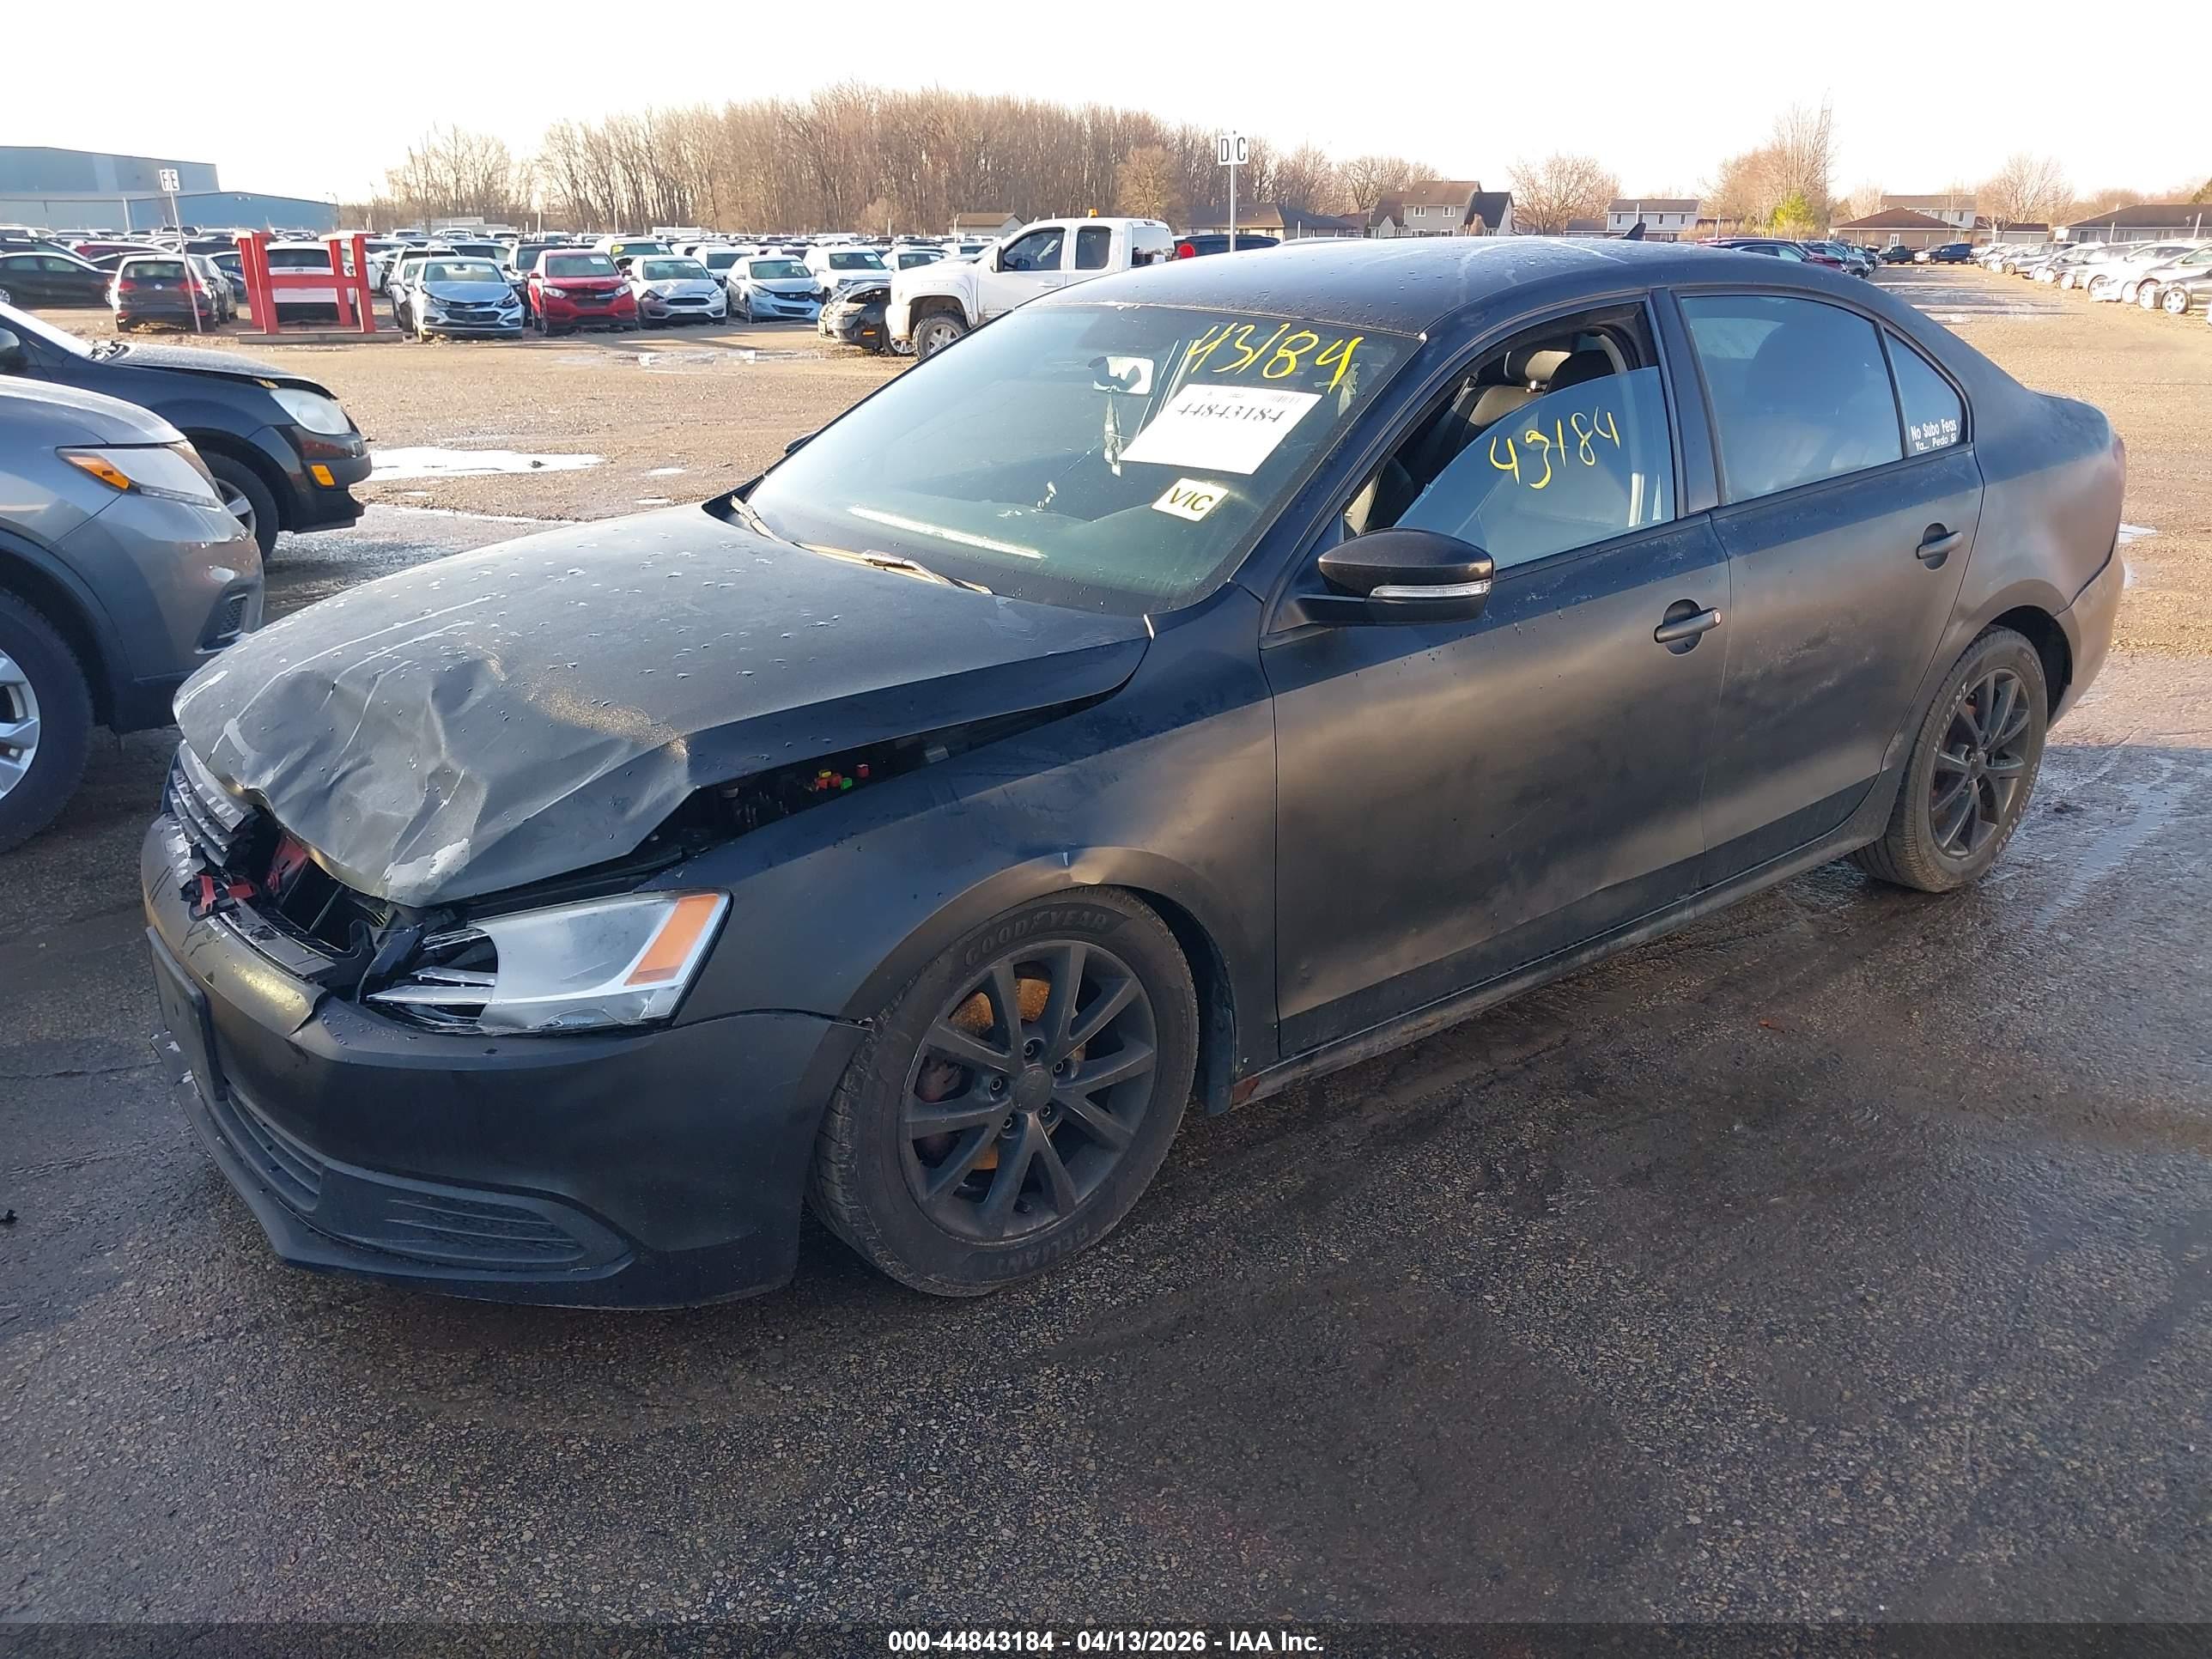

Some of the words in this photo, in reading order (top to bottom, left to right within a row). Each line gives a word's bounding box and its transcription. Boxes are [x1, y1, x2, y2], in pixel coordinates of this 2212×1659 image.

[1220, 137, 1246, 162] D/C
[1188, 322, 1364, 395] 43184
[1177, 403, 1286, 423] 44843184
[1911, 425, 1922, 441] No
[1923, 422, 1940, 438] Subo
[1941, 418, 1957, 434] Feas
[1932, 434, 1948, 447] Pedo
[1490, 406, 1620, 489] 43184
[1169, 488, 1213, 513] VIC
